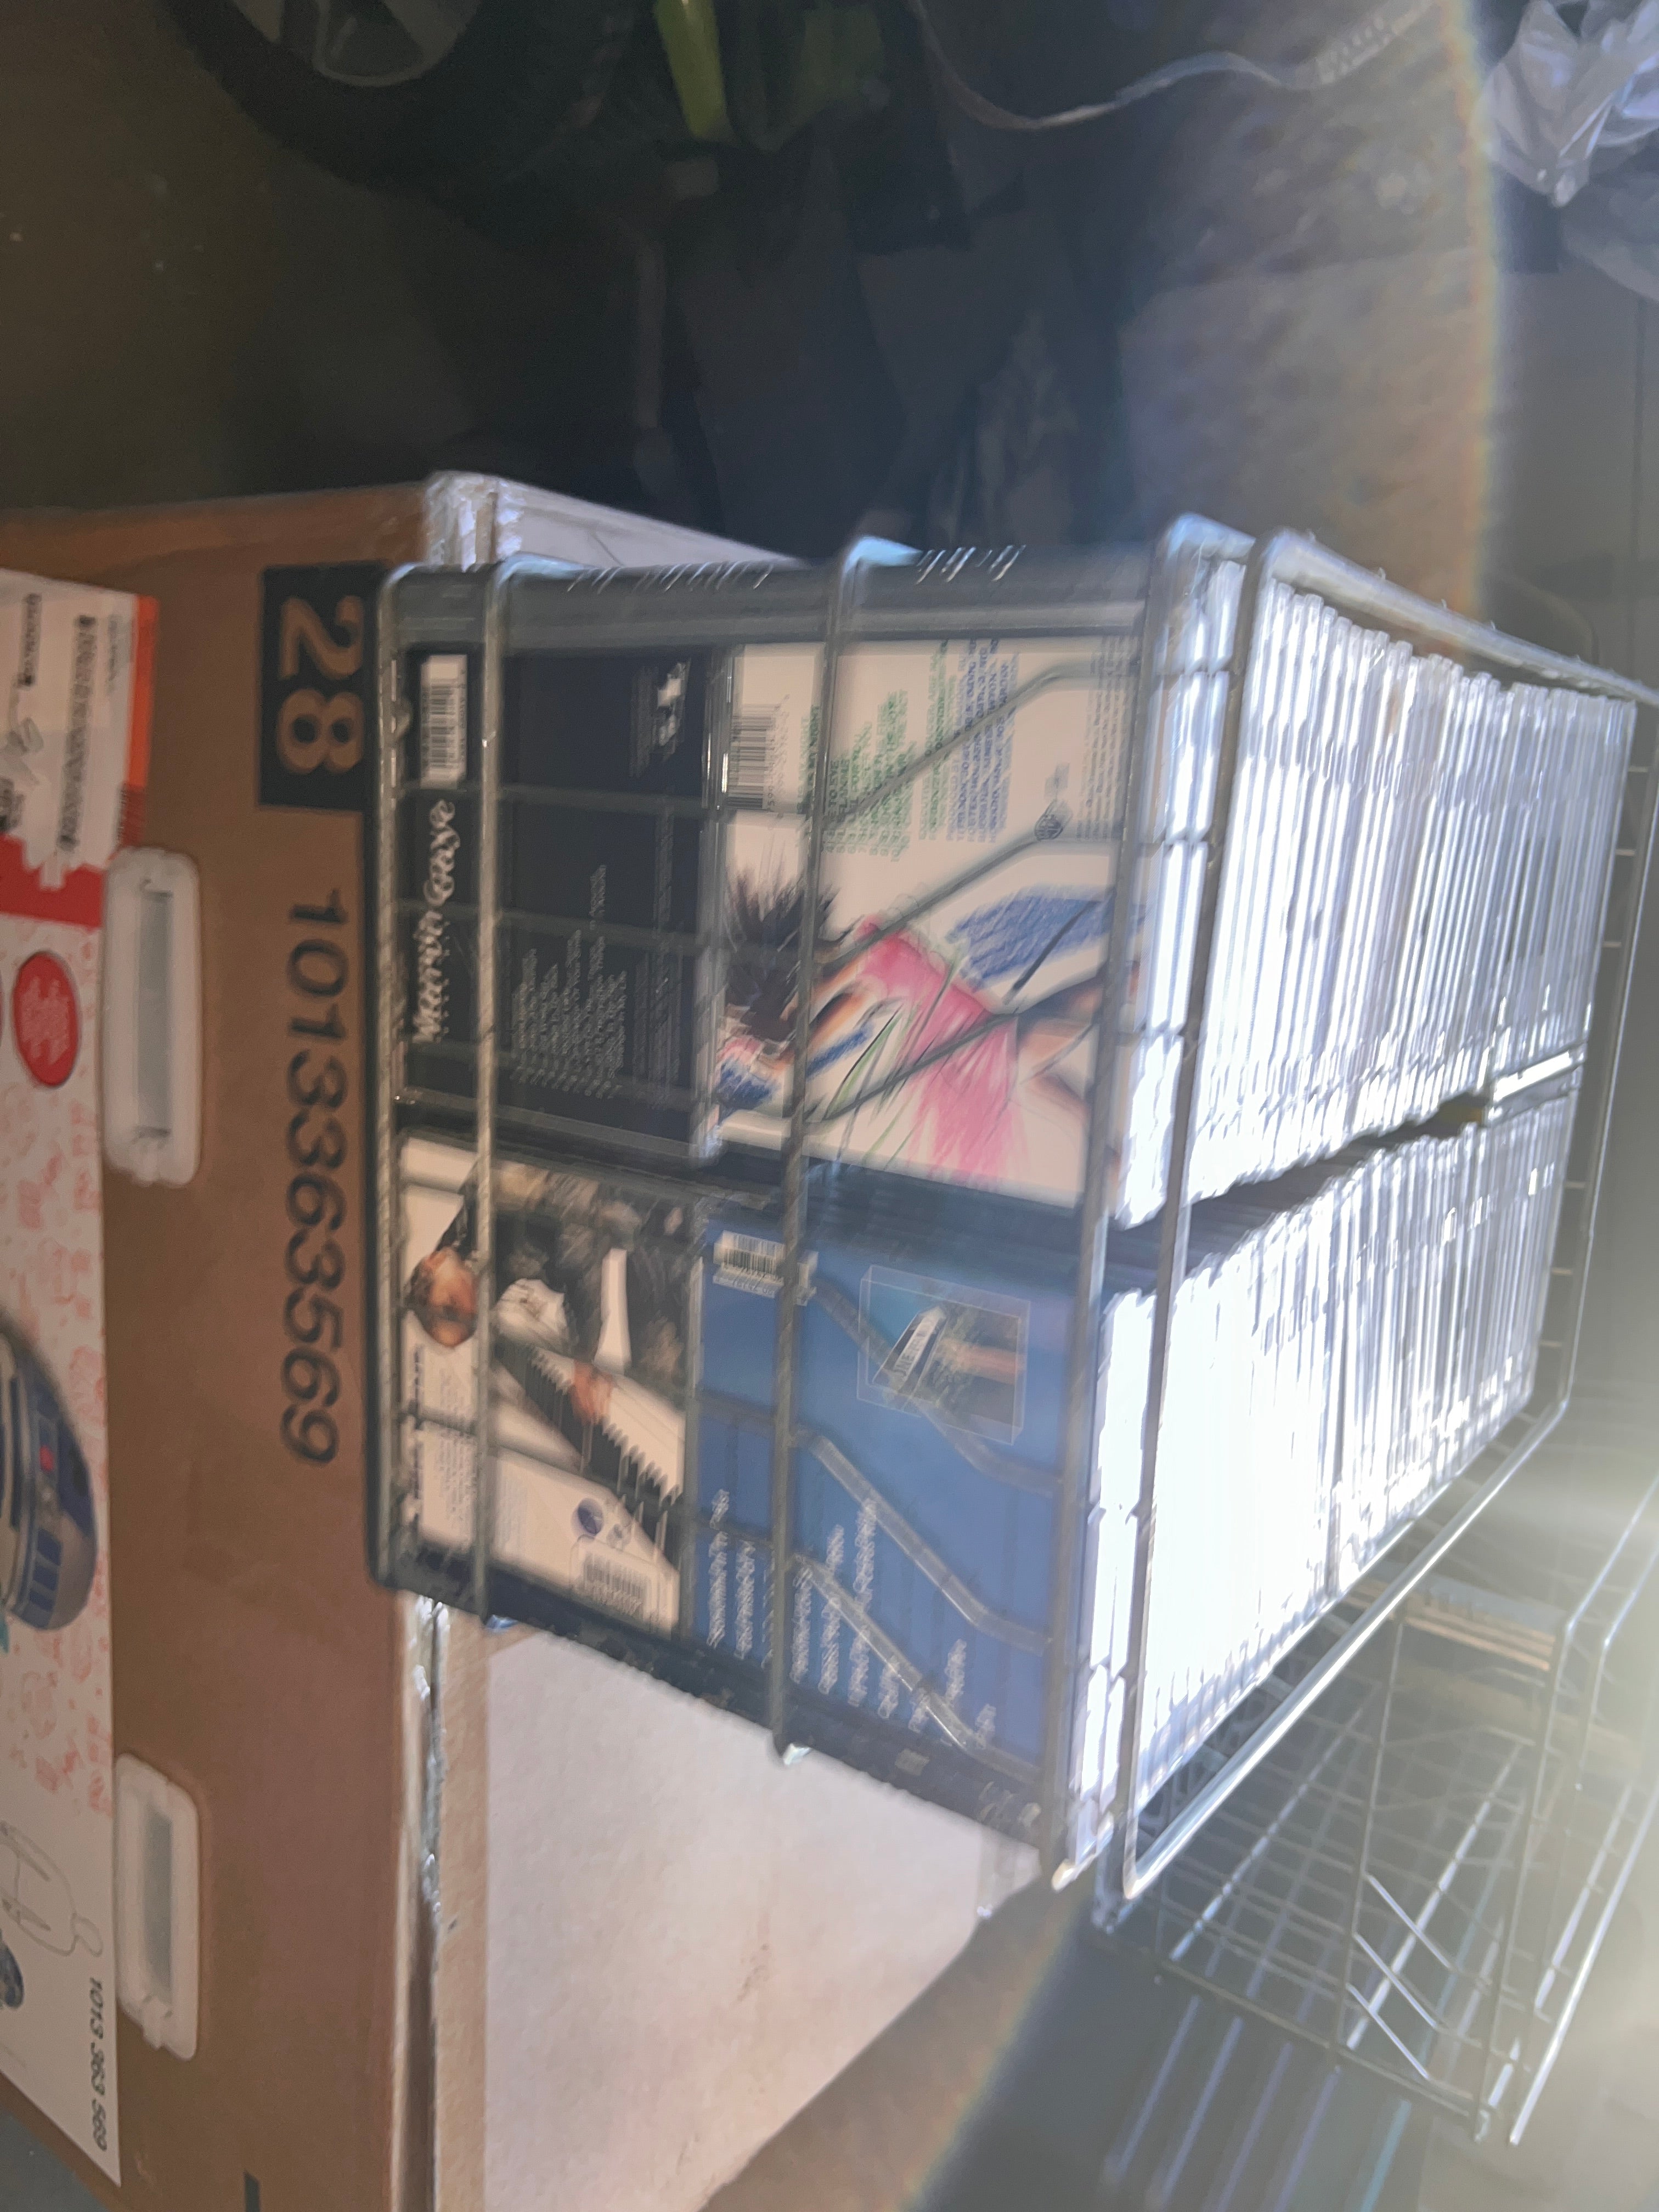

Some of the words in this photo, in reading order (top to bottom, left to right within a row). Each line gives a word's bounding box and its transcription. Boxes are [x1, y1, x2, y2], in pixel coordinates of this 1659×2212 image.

[276, 595, 365, 775] 28
[423, 799, 461, 905] Gaye
[280, 887, 349, 1468] 1013363569
[89, 1977, 104, 2039] 1013
[90, 2042, 105, 2095] 363
[91, 2097, 108, 2151] 569
